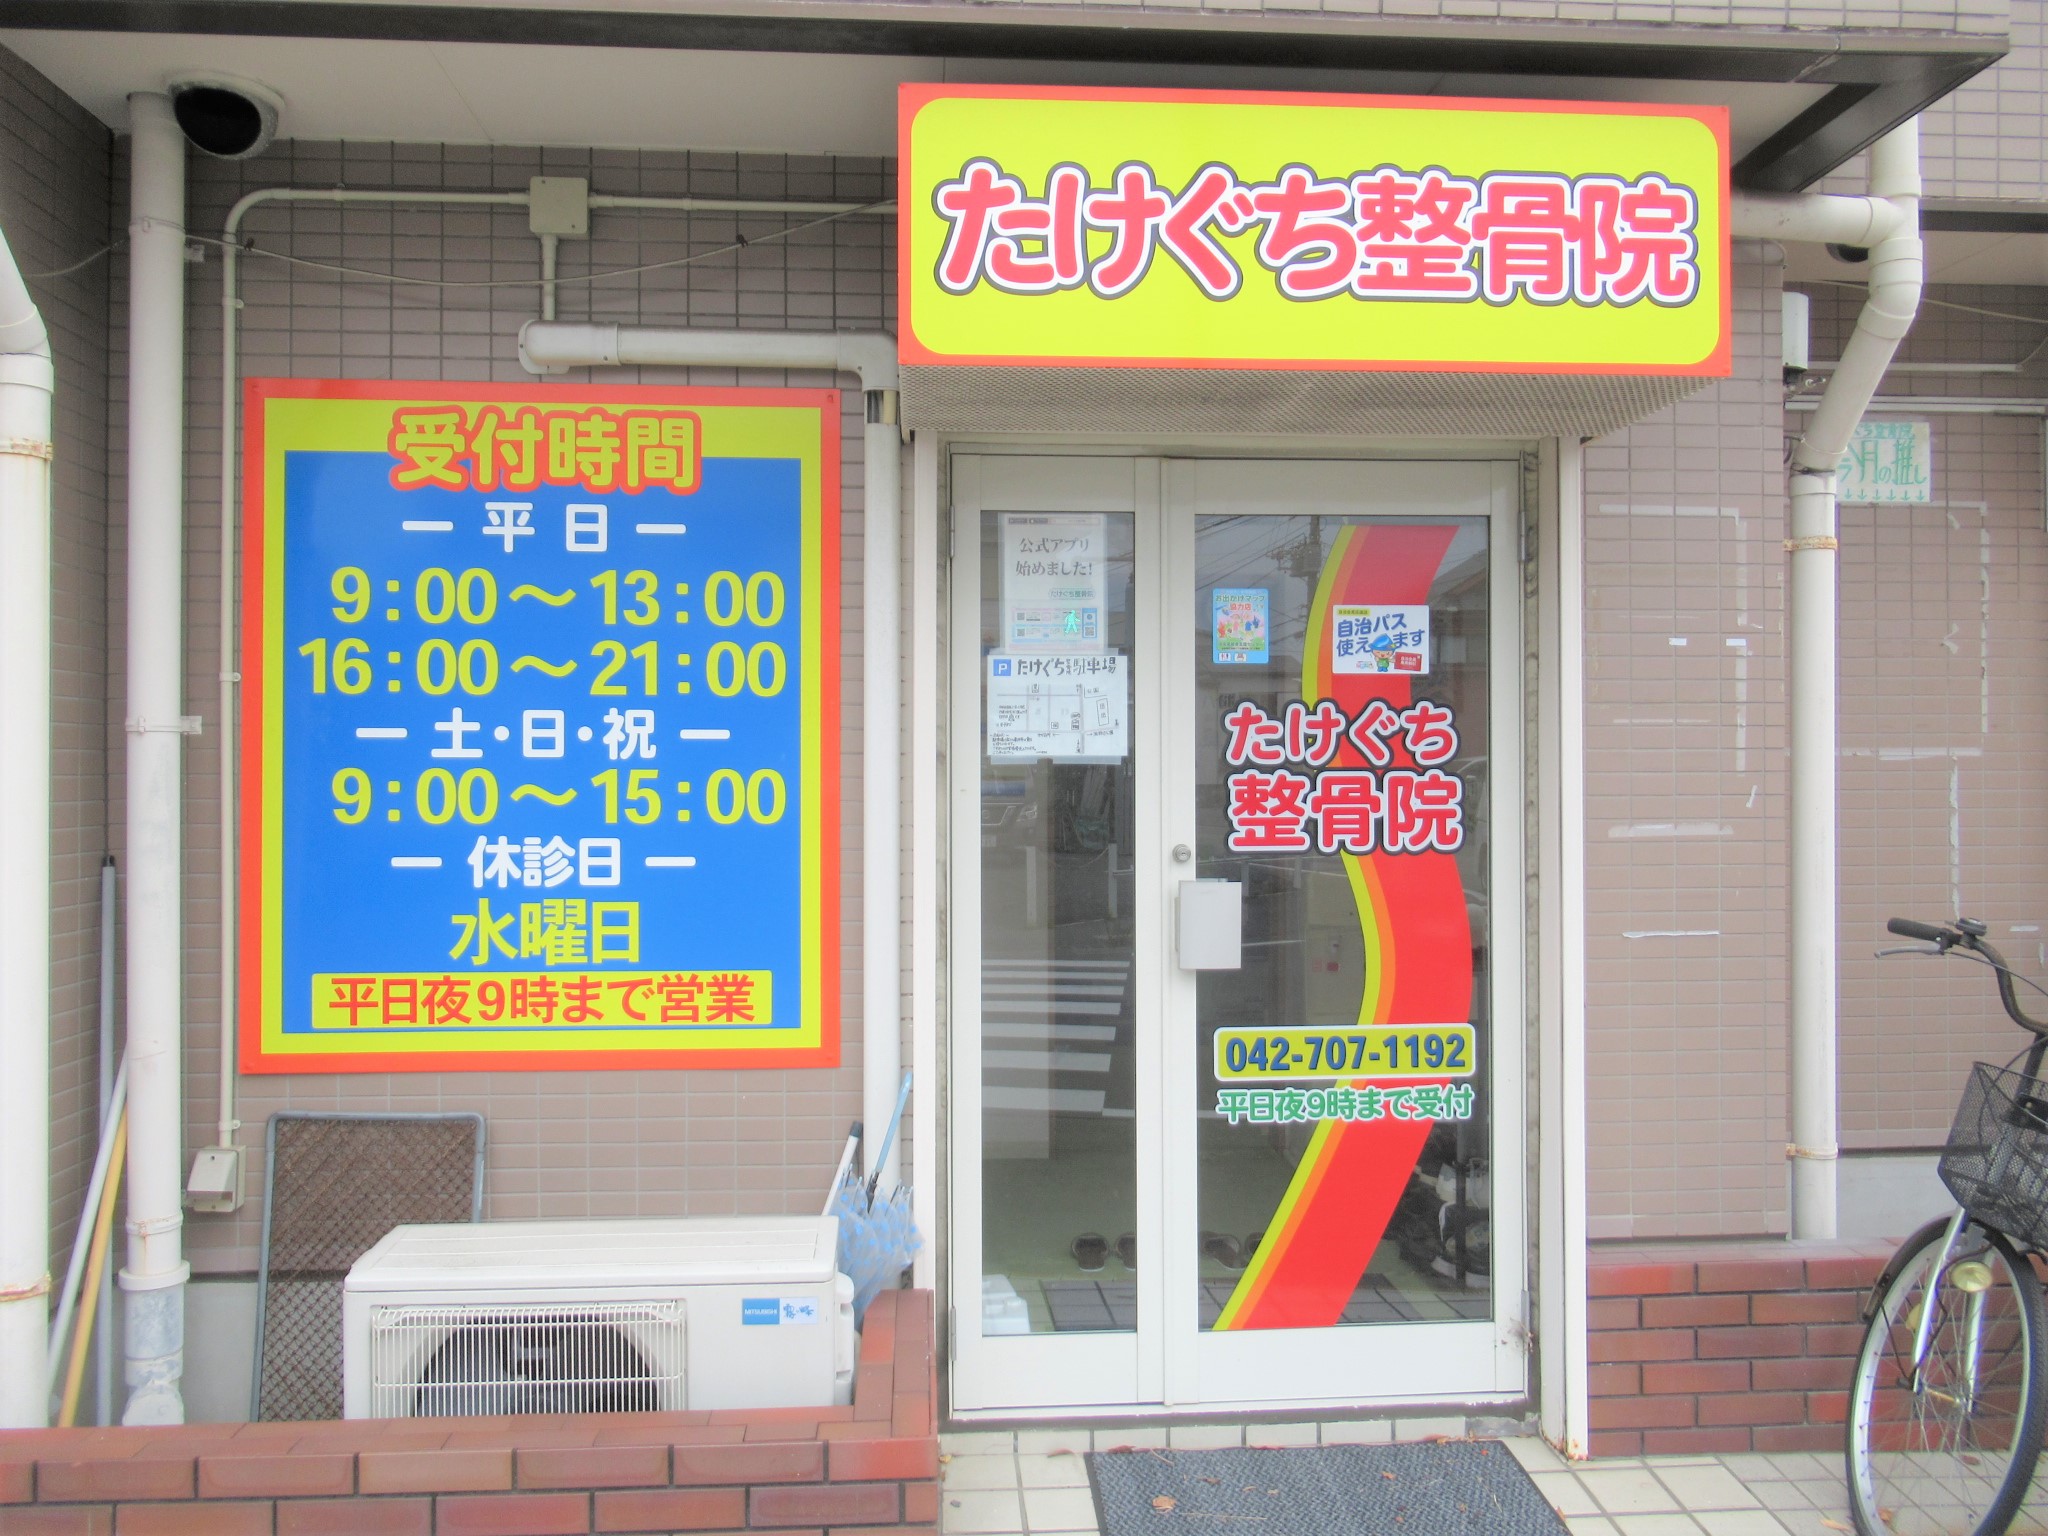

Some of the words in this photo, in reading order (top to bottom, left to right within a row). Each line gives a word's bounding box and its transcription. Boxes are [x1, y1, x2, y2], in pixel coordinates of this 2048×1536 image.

[935, 159, 1697, 305] たけぐち整骨院
[392, 407, 698, 492] 受付時間
[1020, 537, 1089, 553] 公式アプリ
[1338, 613, 1407, 638] 自治パス
[1225, 701, 1457, 765] たけぐち
[1228, 769, 1462, 852] 整骨院
[467, 835, 621, 888] 休診日
[449, 897, 640, 966] 水曜日
[329, 973, 756, 1026] 平日夜9時まで営業
[1226, 1034, 1466, 1072] 042-707-1192
[1216, 1083, 1474, 1125] 平日夜9時まで受付
